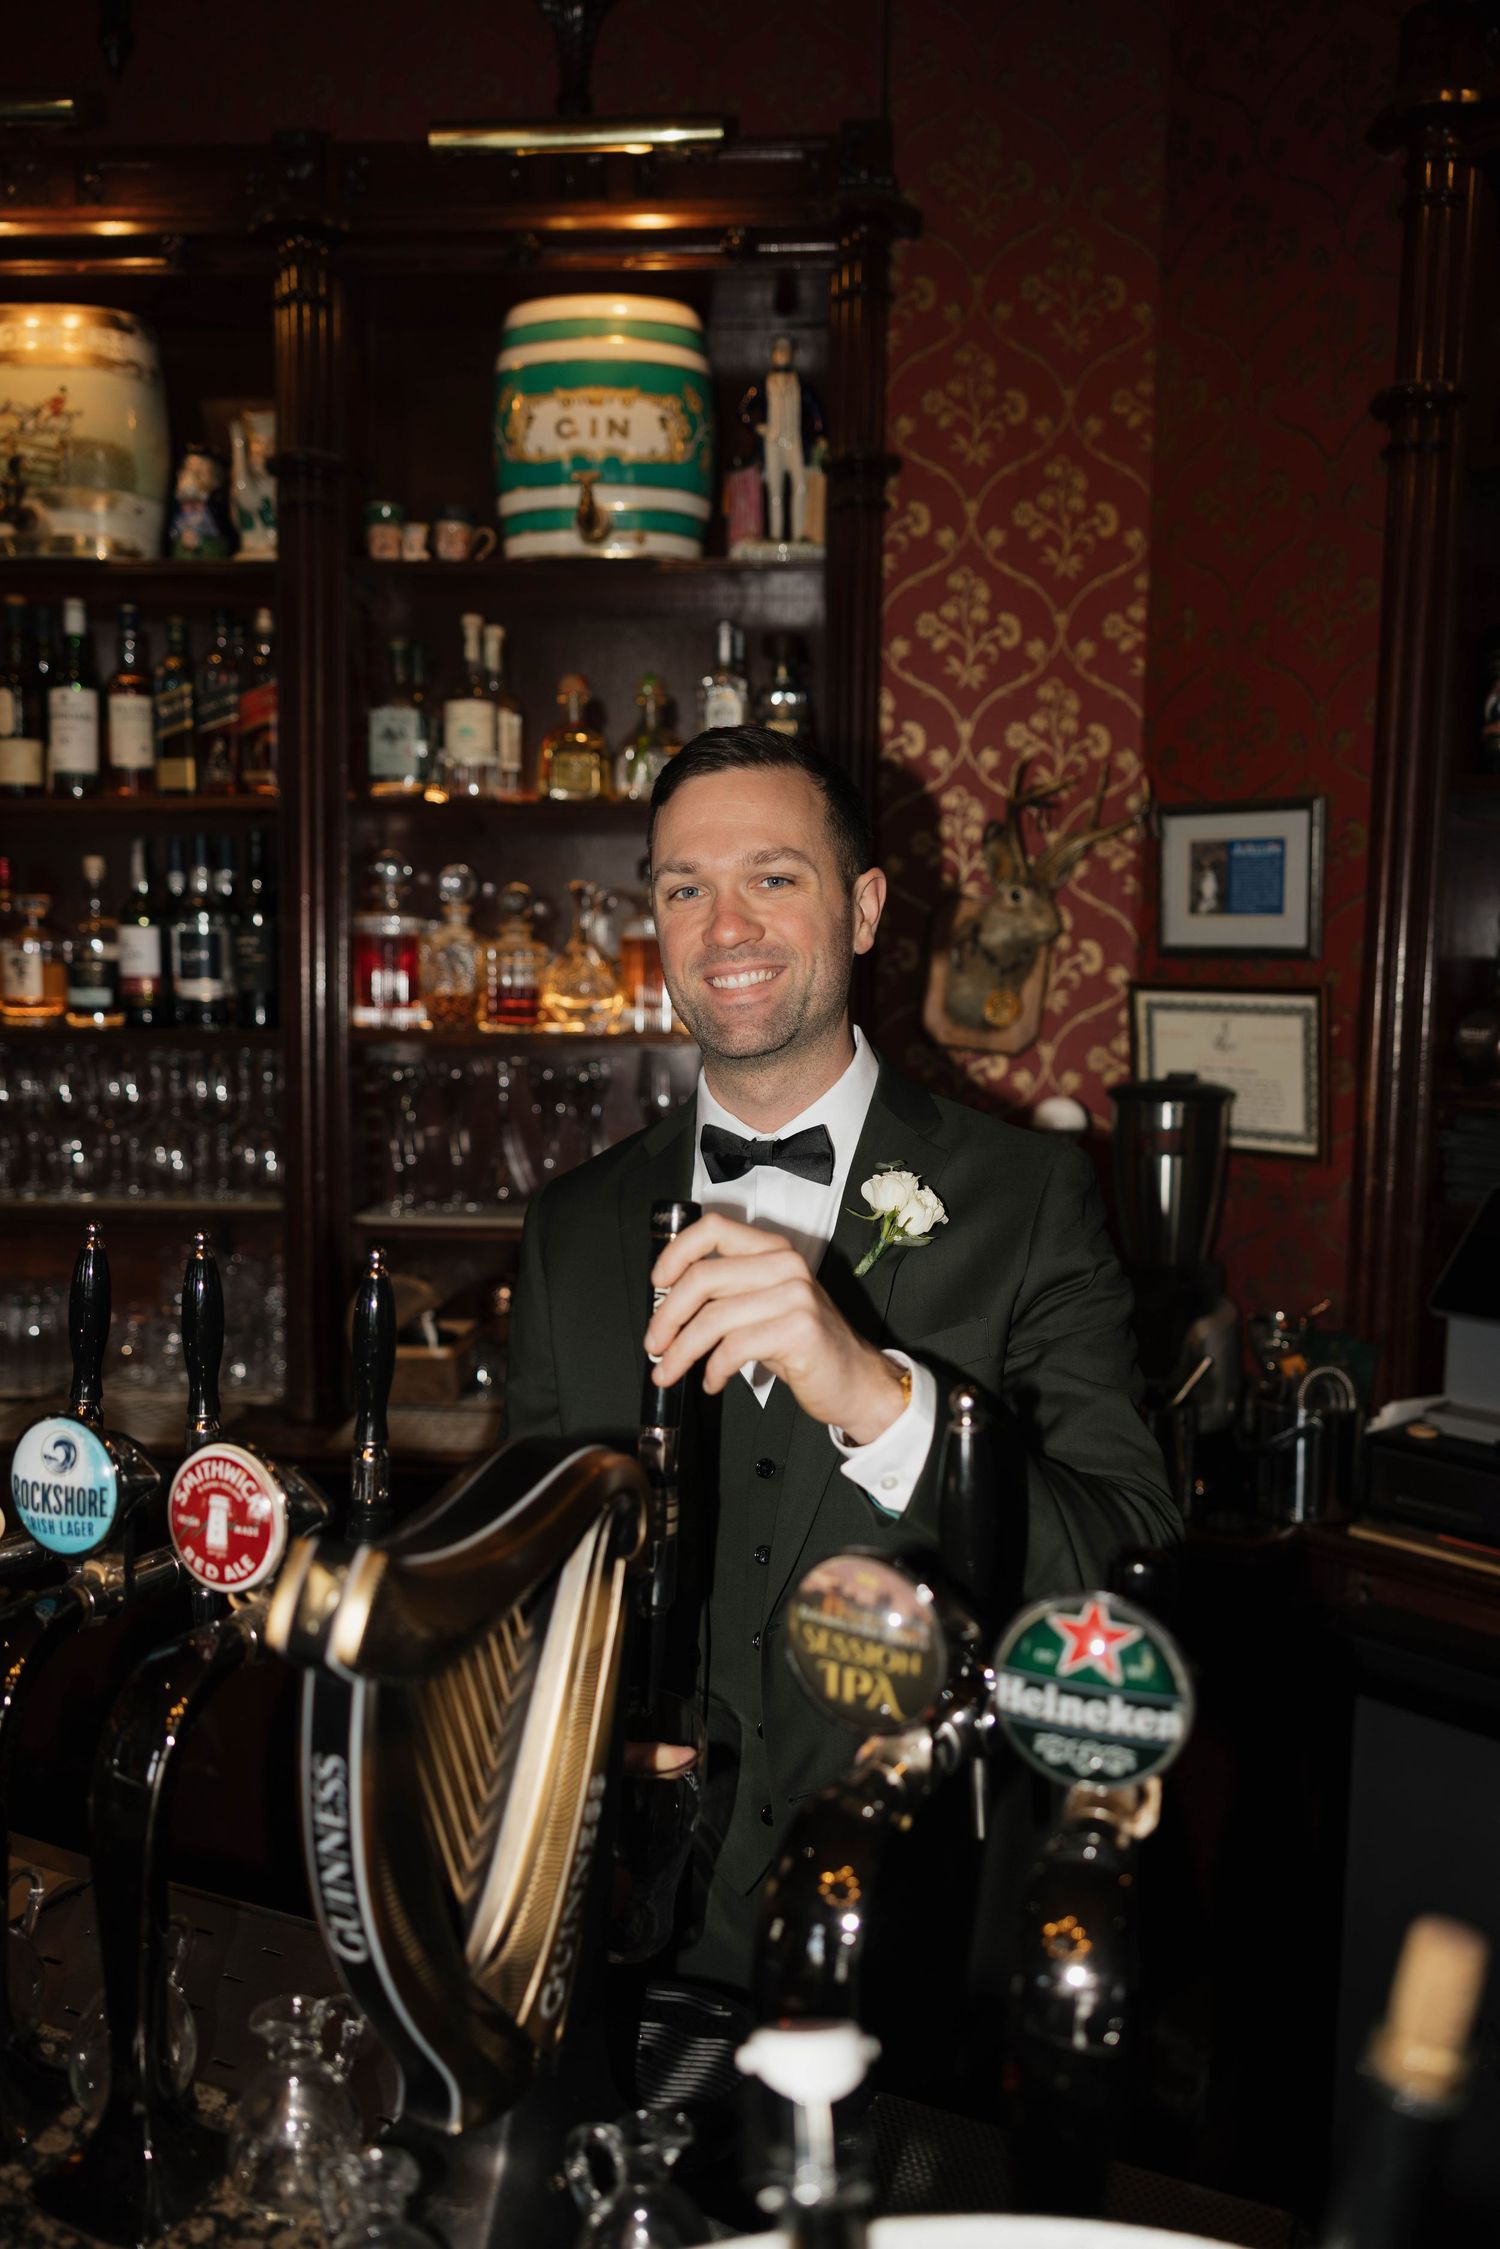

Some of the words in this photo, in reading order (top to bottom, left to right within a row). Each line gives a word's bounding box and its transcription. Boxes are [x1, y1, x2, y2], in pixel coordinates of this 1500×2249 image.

[554, 416, 630, 440] GIN
[13, 1474, 108, 1518] ROCKSHORE
[174, 1459, 271, 1521] SMITHWICK
[26, 1515, 56, 1536] IRISH
[61, 1520, 95, 1537] LAGER
[183, 1545, 220, 1580] RED
[224, 1554, 256, 1582] ALE
[802, 1622, 923, 1678] SESSION
[815, 1657, 906, 1723] IPA
[997, 1672, 1184, 1740] Heineken
[312, 1752, 369, 1965] GUINNESS
